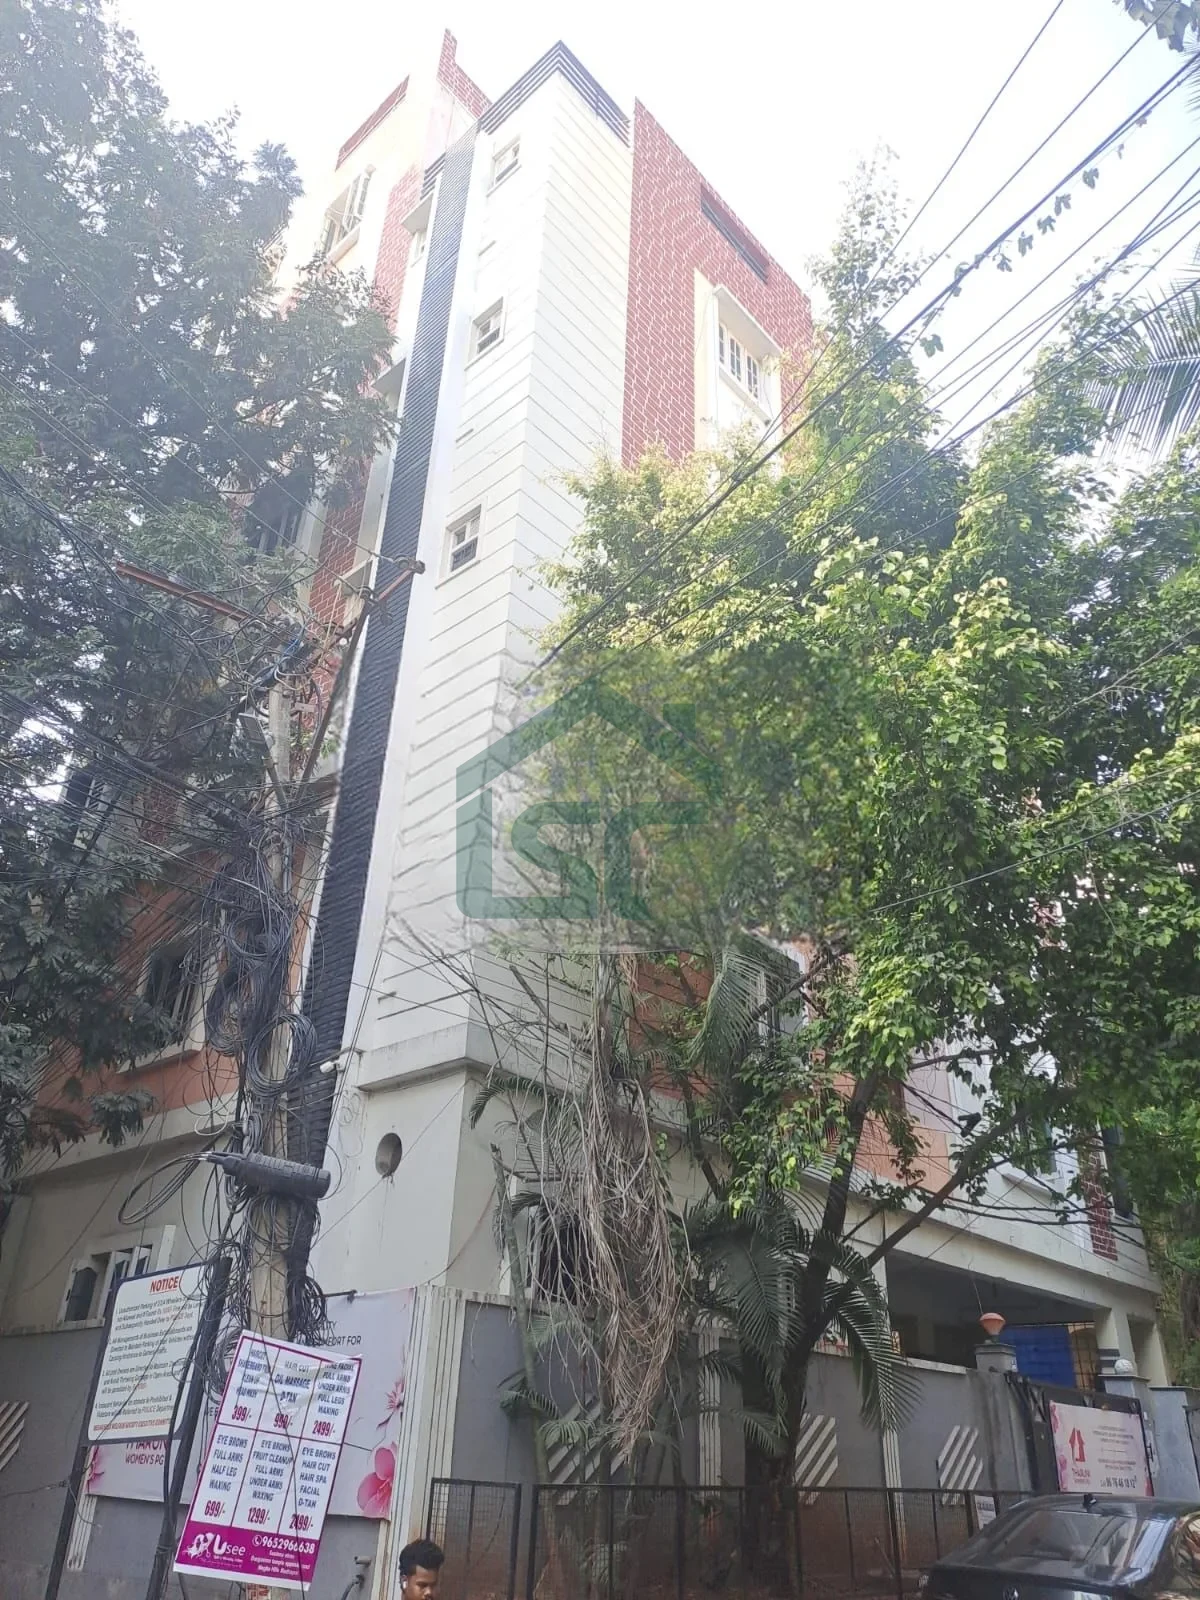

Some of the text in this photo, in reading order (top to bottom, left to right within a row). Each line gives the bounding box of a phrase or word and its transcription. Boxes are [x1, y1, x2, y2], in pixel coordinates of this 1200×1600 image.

[150, 1276, 179, 1292] NOTICE
[347, 1336, 362, 1346] FOR
[232, 1405, 252, 1422] 399/-
[318, 1405, 339, 1416] WAXING
[312, 1420, 335, 1436] 2499/-
[216, 1435, 248, 1448] EYE BROWS
[261, 1440, 291, 1452] EYE BROWS
[213, 1449, 244, 1463] FULL ARMS
[252, 1451, 268, 1462] FRUIT
[302, 1446, 336, 1460] EYE BROWS
[211, 1464, 238, 1477] HALF LEG
[255, 1464, 284, 1476] FULL ARMS
[302, 1460, 331, 1472] HAIR CUT
[249, 1477, 283, 1490] UNDER ARMS
[300, 1472, 327, 1484] HAIR SPA
[209, 1479, 231, 1492] WAXING
[299, 1484, 320, 1496] FACIAL
[252, 1490, 274, 1501] WAXING
[204, 1500, 226, 1518] 699/-
[298, 1497, 317, 1508] D-TAN
[248, 1506, 270, 1524] 1299/-
[289, 1514, 314, 1531] 2499/-
